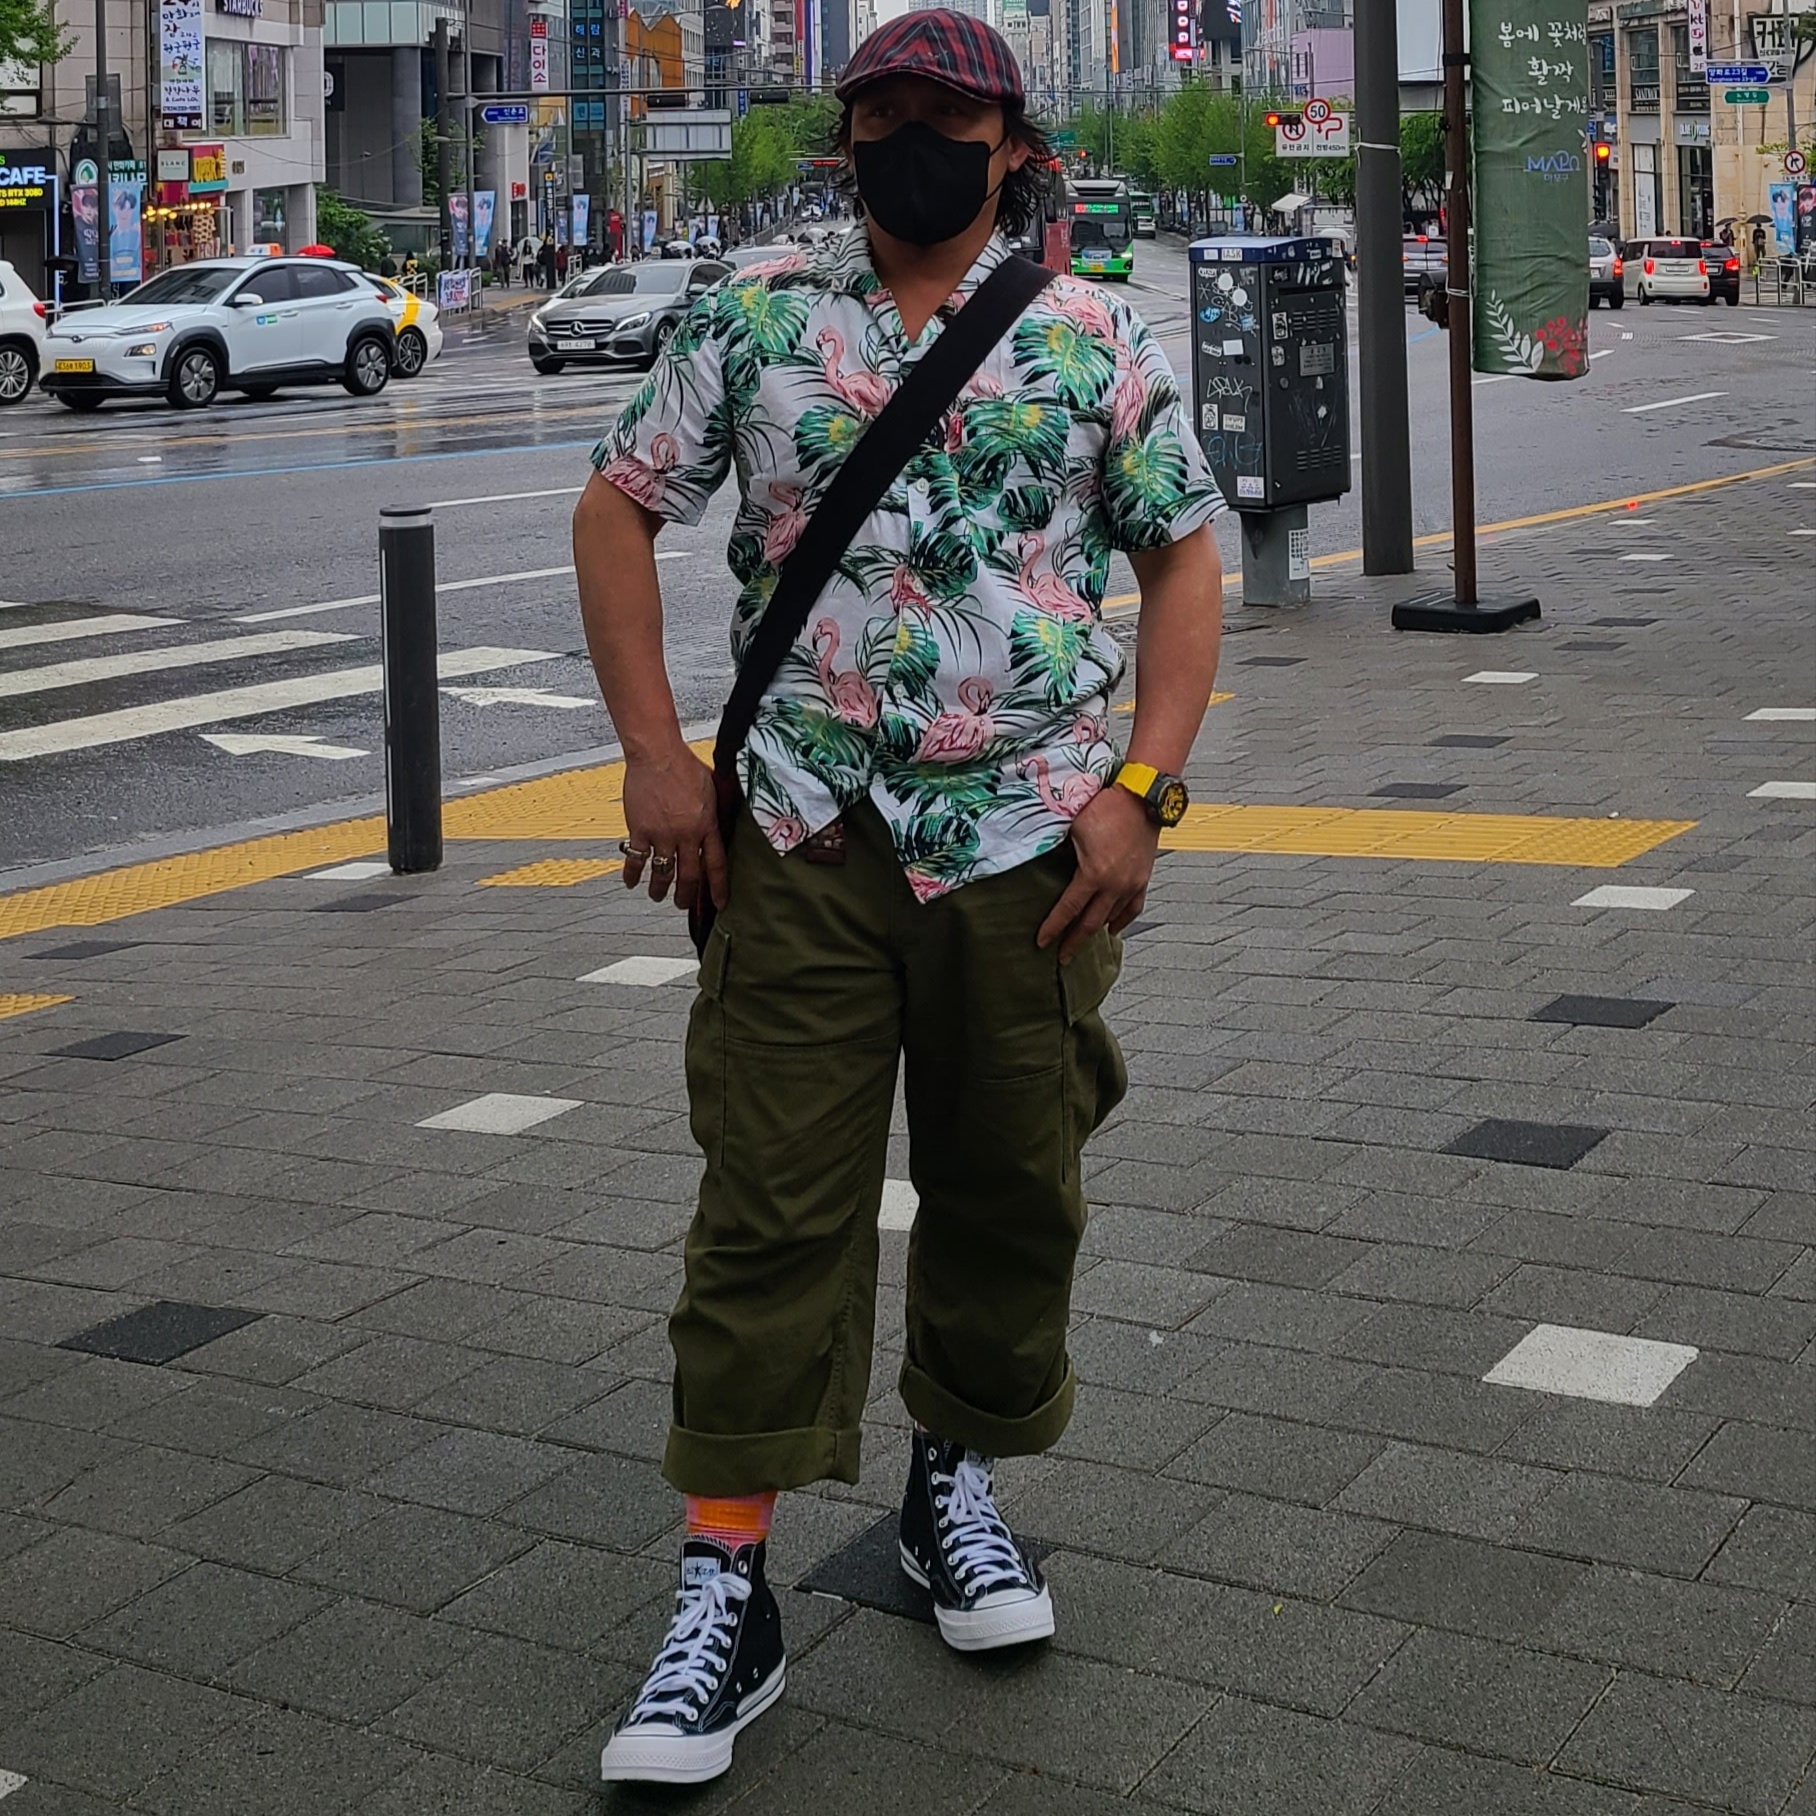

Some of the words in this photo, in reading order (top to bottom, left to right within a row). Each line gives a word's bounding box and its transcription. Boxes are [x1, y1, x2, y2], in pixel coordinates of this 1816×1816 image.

[1691, 14, 1704, 25] kt
[1498, 21, 1539, 48] 봄에
[533, 45, 547, 83] 다이소
[1527, 56, 1574, 86] 활짝
[1310, 105, 1326, 118] 50
[1501, 94, 1588, 120] 피어날게요
[1679, 123, 1692, 136] OLIVE
[0, 166, 46, 186] CAFE
